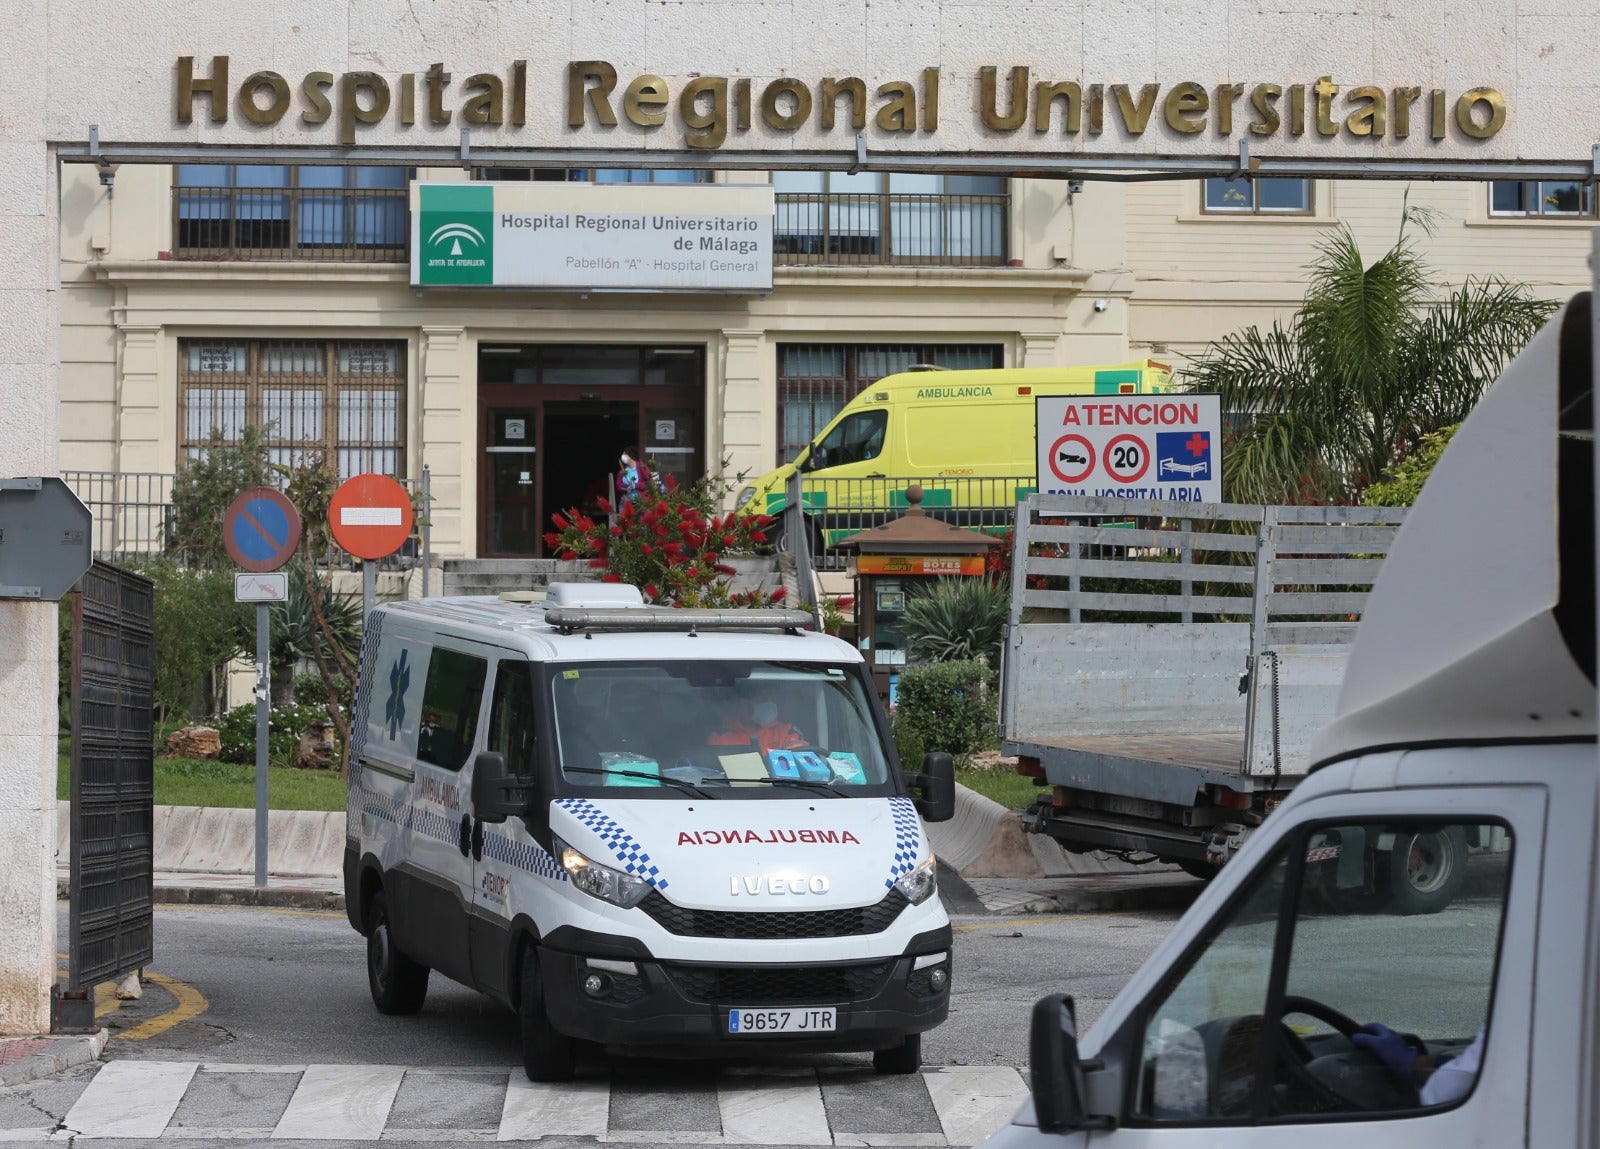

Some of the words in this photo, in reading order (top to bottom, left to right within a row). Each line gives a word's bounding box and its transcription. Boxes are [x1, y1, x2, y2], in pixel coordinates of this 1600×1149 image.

[177, 56, 527, 145] Hospital
[569, 60, 940, 149] Regional
[980, 65, 1507, 140] Universitario
[501, 214, 570, 231] Hospital
[575, 215, 646, 233] Regional
[652, 216, 758, 231] Universitario
[673, 236, 693, 251] de
[699, 236, 758, 255] Málaga
[427, 259, 446, 267] JUNTA
[447, 259, 455, 267] DE
[565, 256, 620, 270] Pabellón
[653, 259, 705, 273] Hospital
[710, 259, 759, 272] General
[203, 362, 228, 370] LIBROS
[917, 387, 992, 399] AMBULANCIA
[1062, 403, 1198, 426] ATENCION
[1113, 446, 1139, 469] 20
[944, 468, 974, 476] TENORIO
[923, 561, 961, 569] BOTES
[420, 776, 460, 811] AMBULANCIA
[730, 874, 830, 897] IVECO
[743, 1012, 791, 1030] 9657
[798, 1011, 832, 1029] JTR
